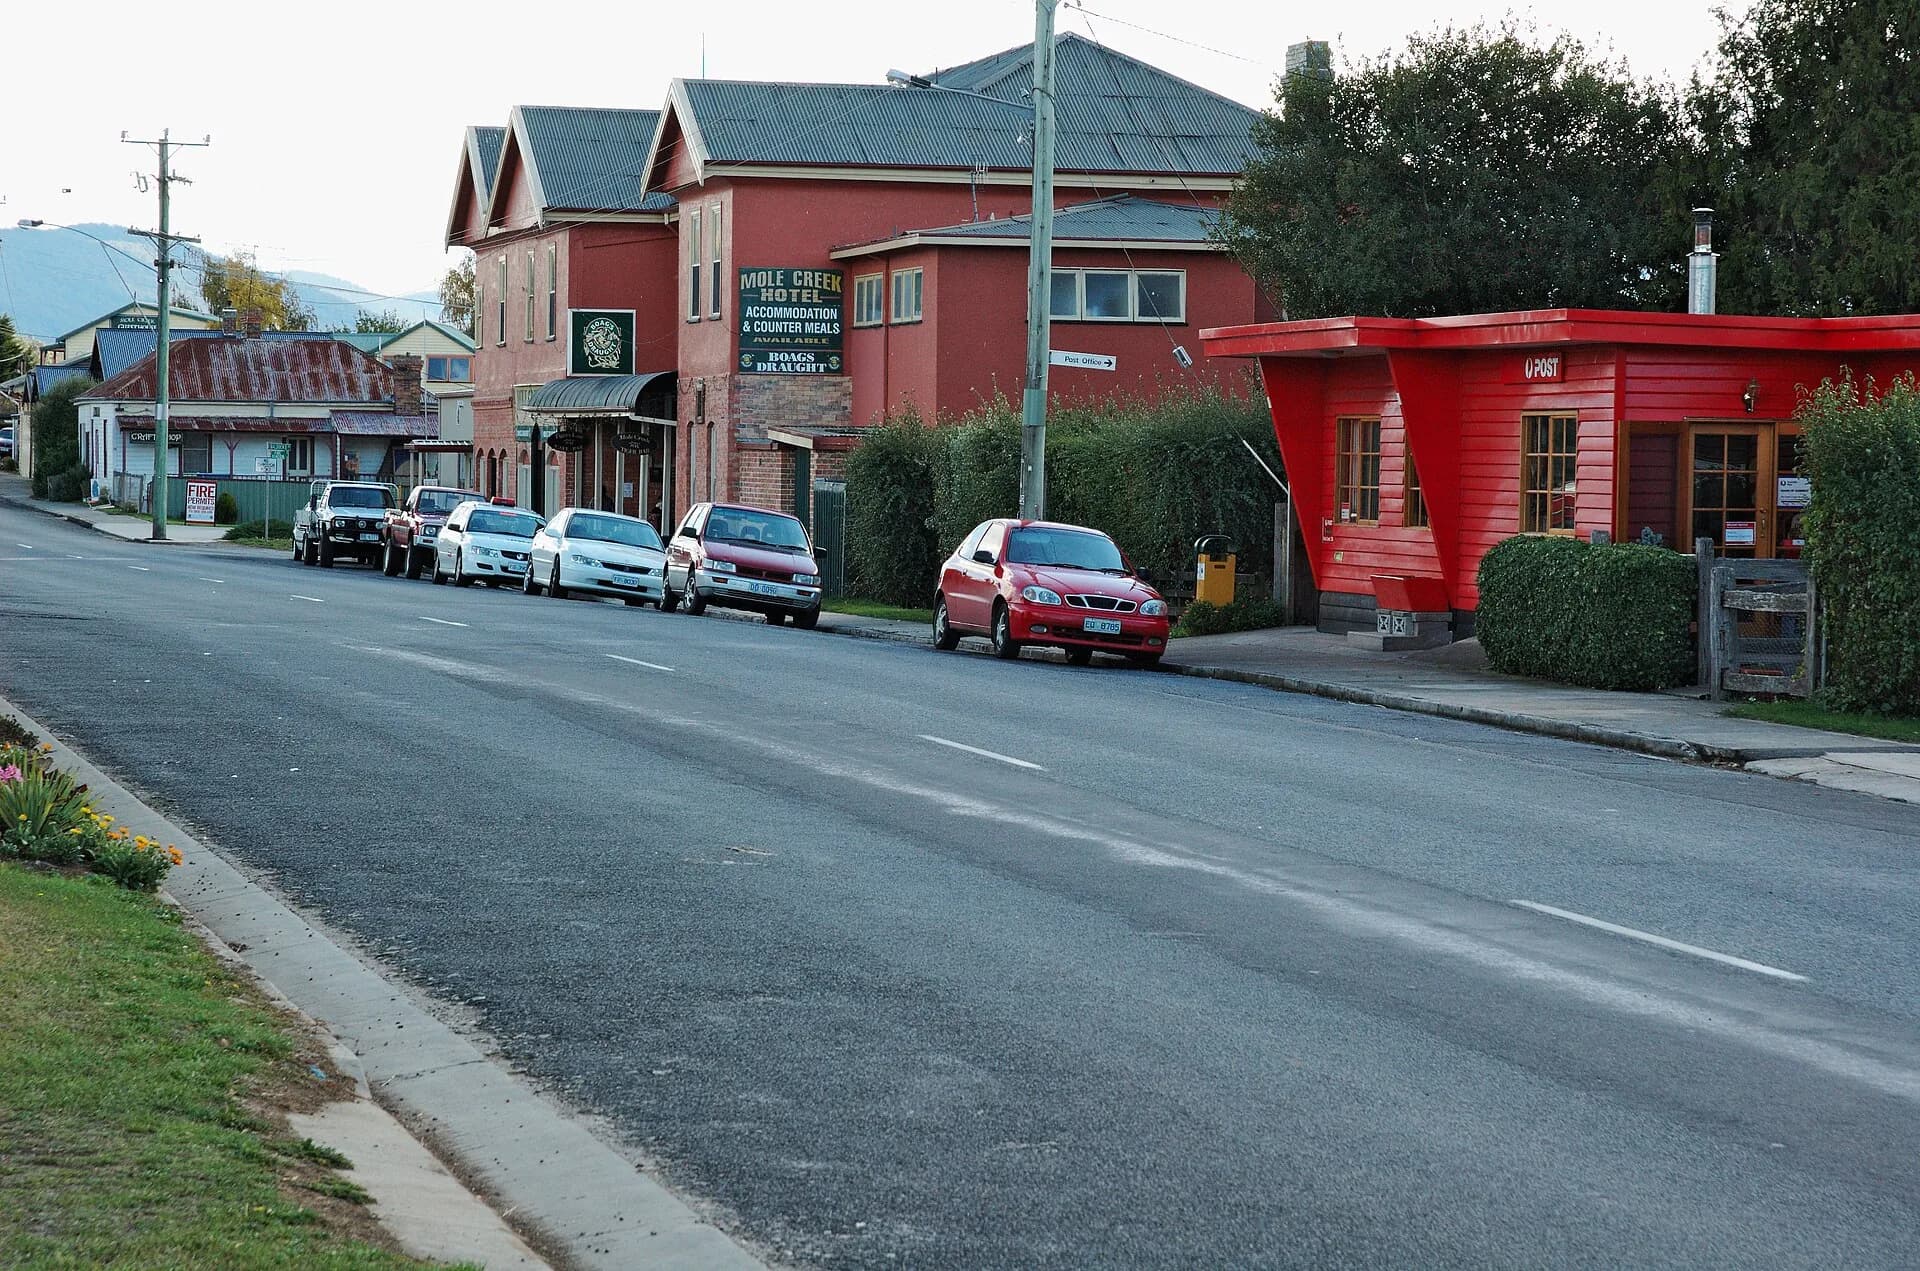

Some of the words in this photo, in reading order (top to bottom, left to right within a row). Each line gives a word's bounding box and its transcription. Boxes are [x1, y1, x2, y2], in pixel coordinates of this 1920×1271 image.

[741, 270, 784, 290] MOLE
[792, 270, 842, 293] CREEK
[760, 288, 823, 303] HOTEL
[745, 306, 838, 320] ACCOMMODATION
[742, 320, 751, 332] &
[753, 321, 802, 333] COUNTER
[804, 322, 840, 334] MEALS
[752, 337, 830, 345] AVAILABLE
[768, 352, 815, 363] BOAGS
[1064, 355, 1079, 364] Post
[1081, 357, 1102, 366] Office
[756, 362, 827, 373] DRAUGHT
[1534, 357, 1559, 378] POST
[188, 484, 215, 498] FIRE
[187, 497, 215, 506] PERMITS
[1100, 622, 1120, 631] 8785
